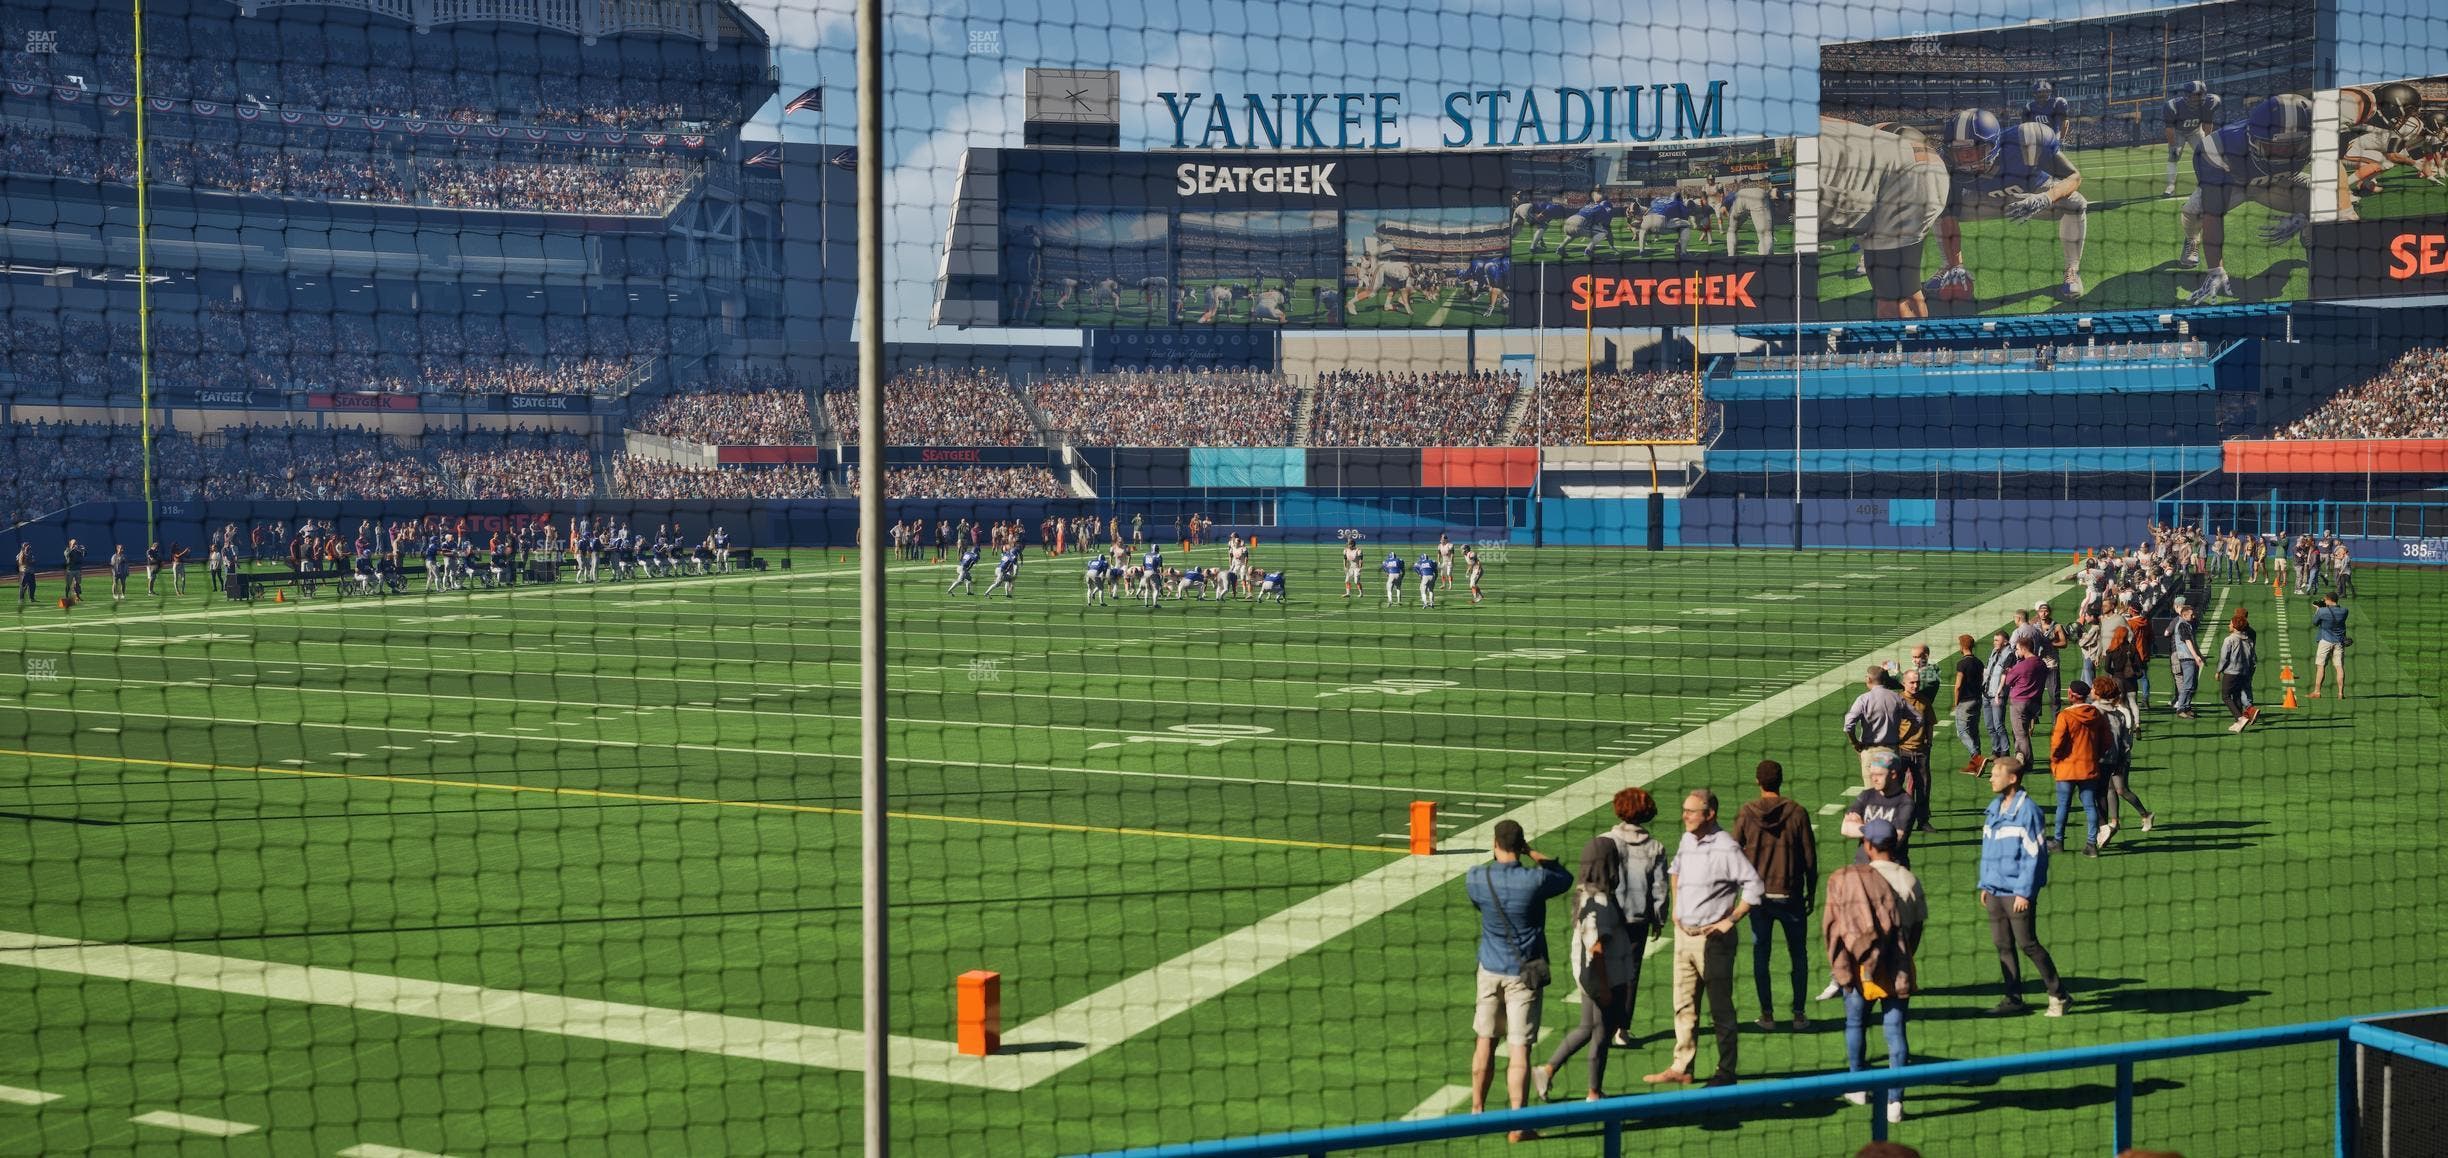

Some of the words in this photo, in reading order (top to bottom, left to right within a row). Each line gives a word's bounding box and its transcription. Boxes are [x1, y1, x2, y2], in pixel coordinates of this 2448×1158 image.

[1157, 92, 1401, 149] YANKEE
[1443, 80, 1728, 147] STADIUM
[1177, 162, 1338, 197] SEATGEEK
[2389, 233, 2448, 280] SE
[1571, 270, 1758, 312] SEATGEEK
[194, 390, 253, 404] SEATGEEK
[335, 396, 392, 408] SEATGEEK
[512, 396, 568, 409] SEATGEEK
[922, 449, 981, 462] SEATGEEK
[424, 512, 550, 537] SATGEEK
